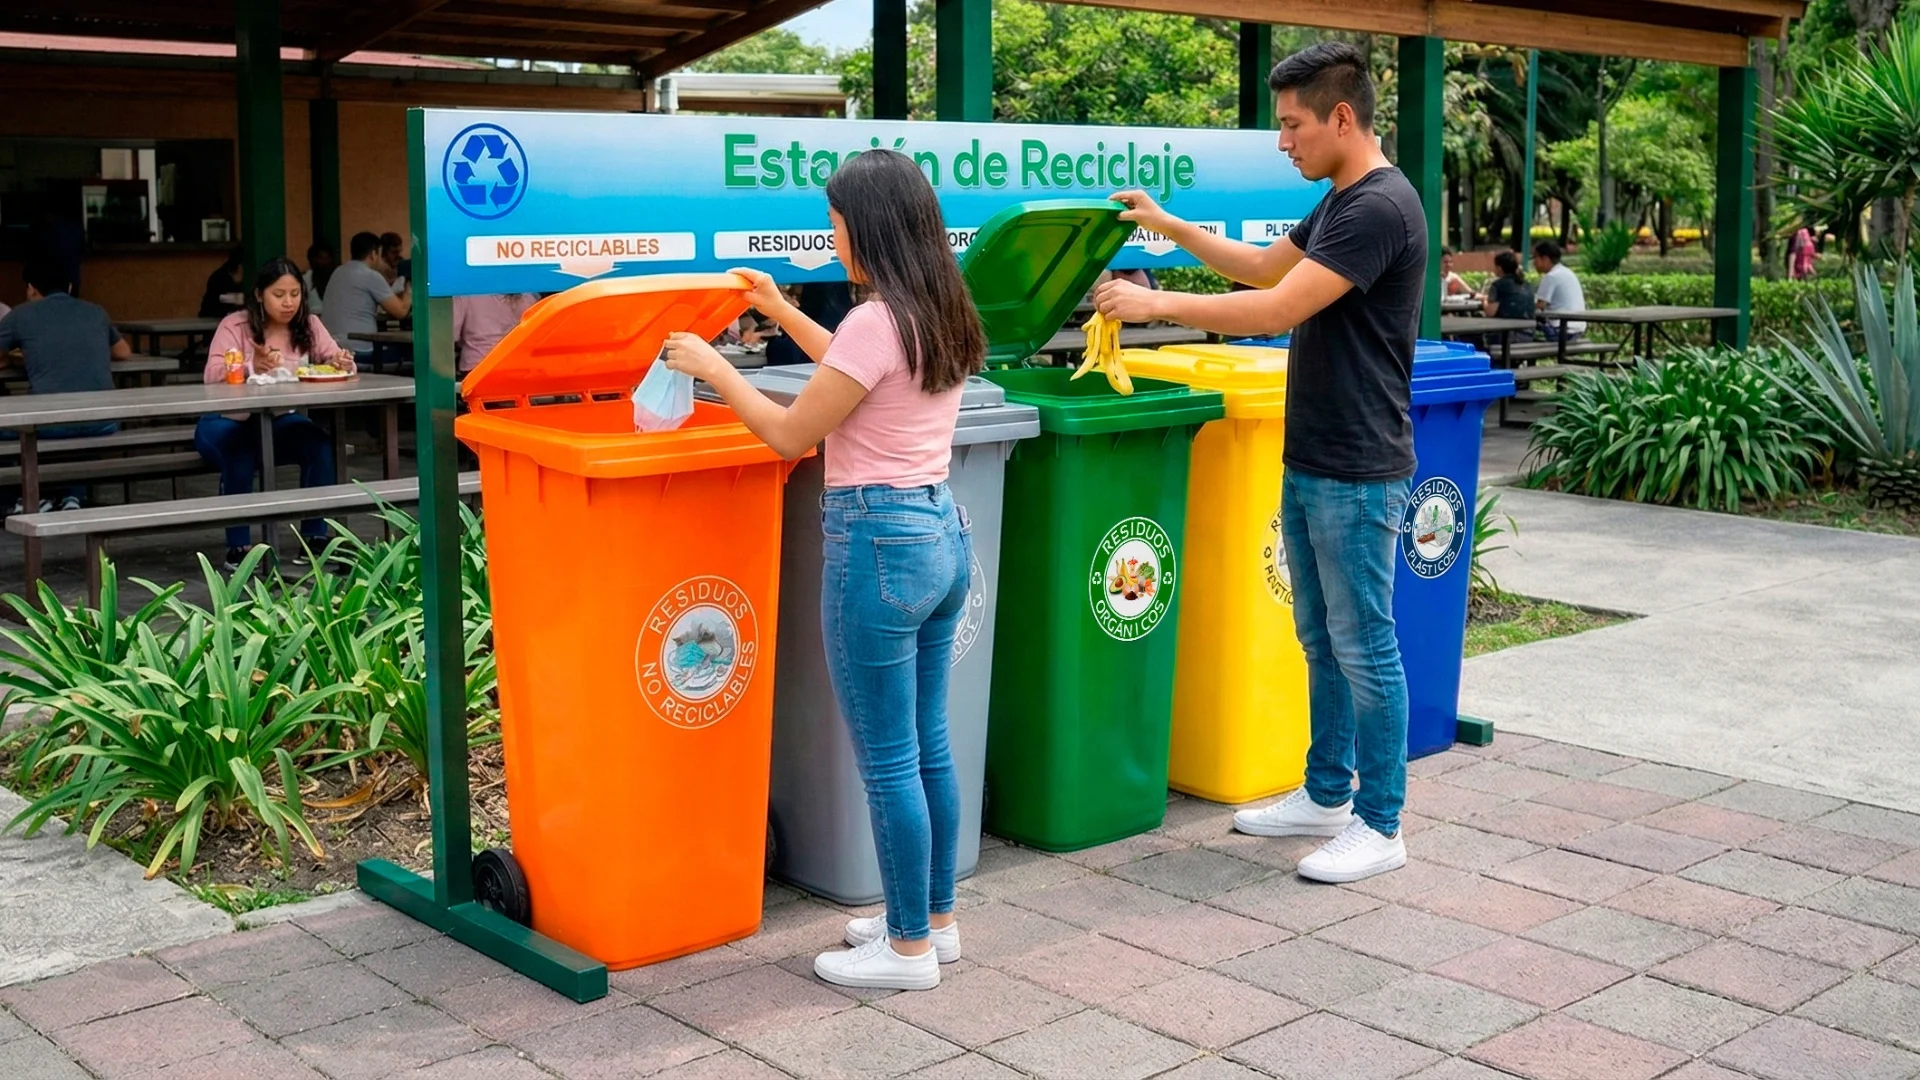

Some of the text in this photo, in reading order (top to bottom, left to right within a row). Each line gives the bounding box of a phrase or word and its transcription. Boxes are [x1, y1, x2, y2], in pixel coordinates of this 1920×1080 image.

[724, 133, 1195, 202] Estan de Reciclaje
[496, 238, 660, 259] NO RECICLABLES
[1410, 481, 1462, 512] RESIDUOS
[1101, 521, 1171, 558] RESIDUOS
[1407, 548, 1456, 575] PLÁSTICOS
[649, 581, 748, 635] RESIDUOS
[1095, 599, 1165, 638] ORGÁNICOS
[642, 640, 755, 724] NO RECICLABLES
